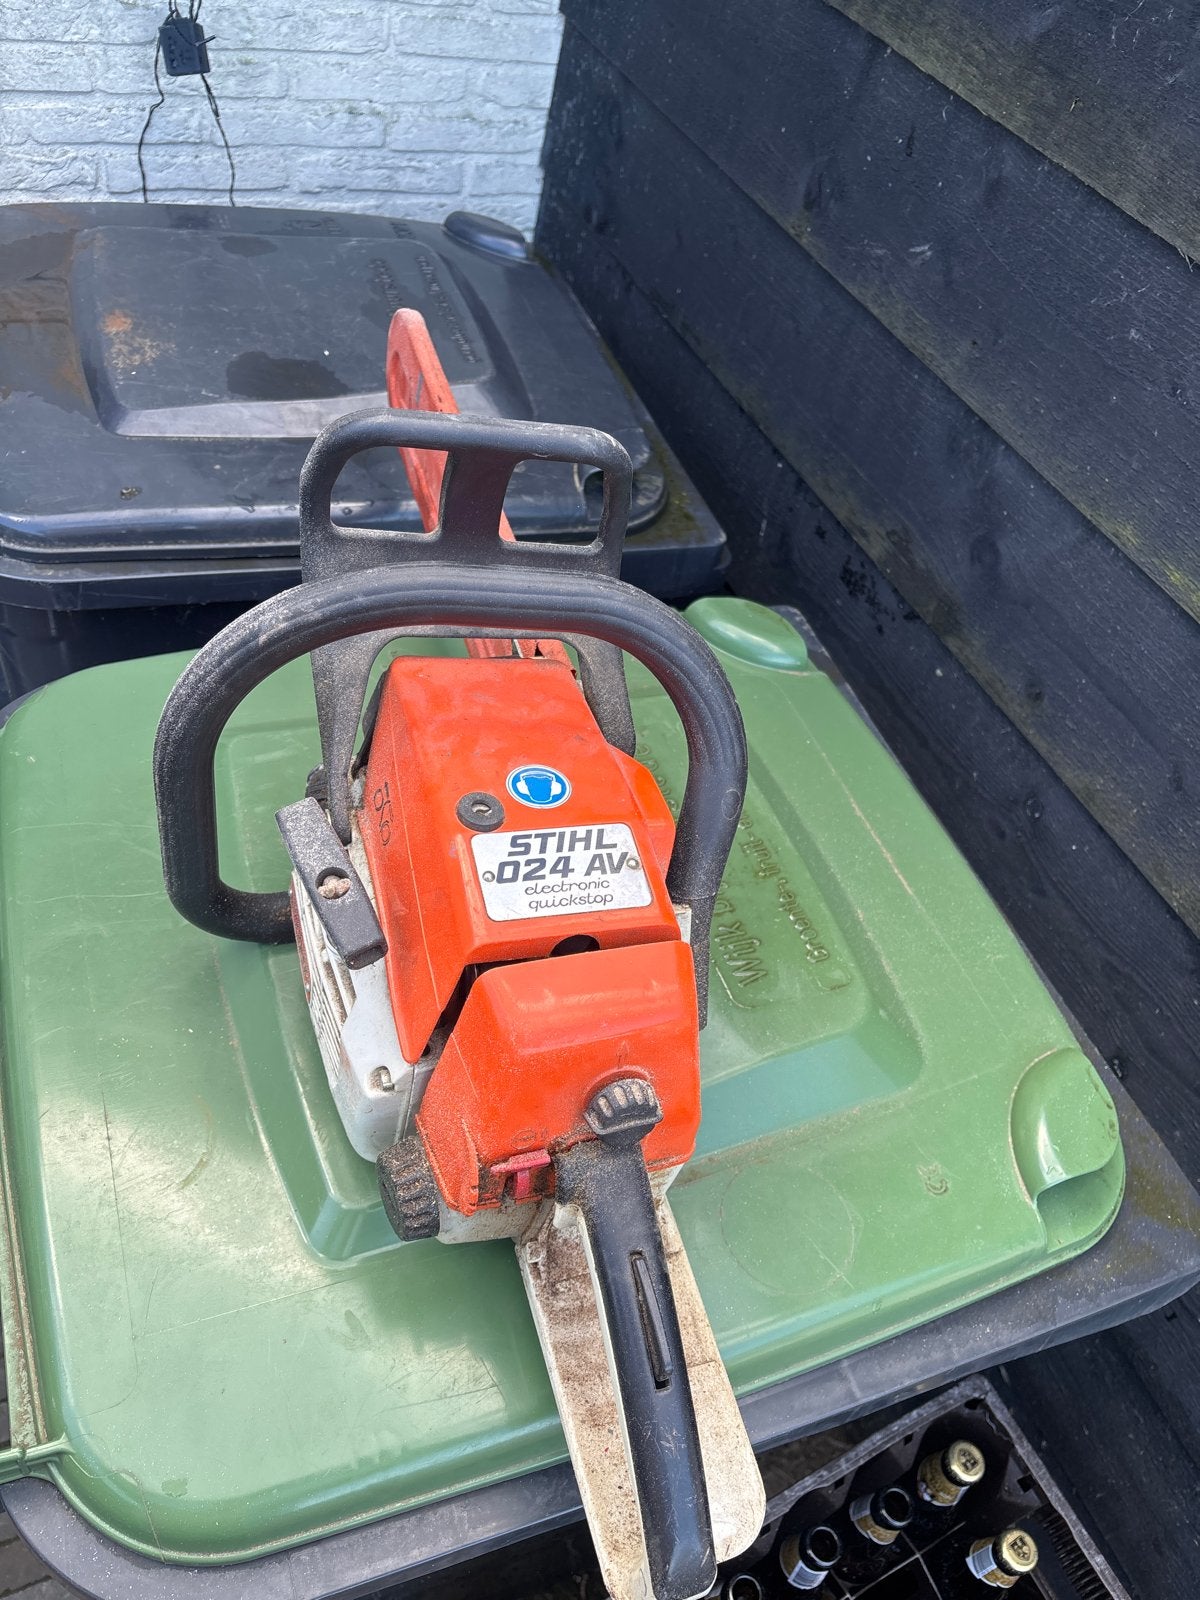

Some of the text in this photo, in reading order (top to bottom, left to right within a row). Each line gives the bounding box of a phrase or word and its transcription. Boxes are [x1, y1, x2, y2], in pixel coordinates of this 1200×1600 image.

[507, 828, 618, 858] STIHL
[496, 851, 629, 884] 024 AV
[524, 877, 610, 896] electronic
[528, 892, 614, 912] quickstop
